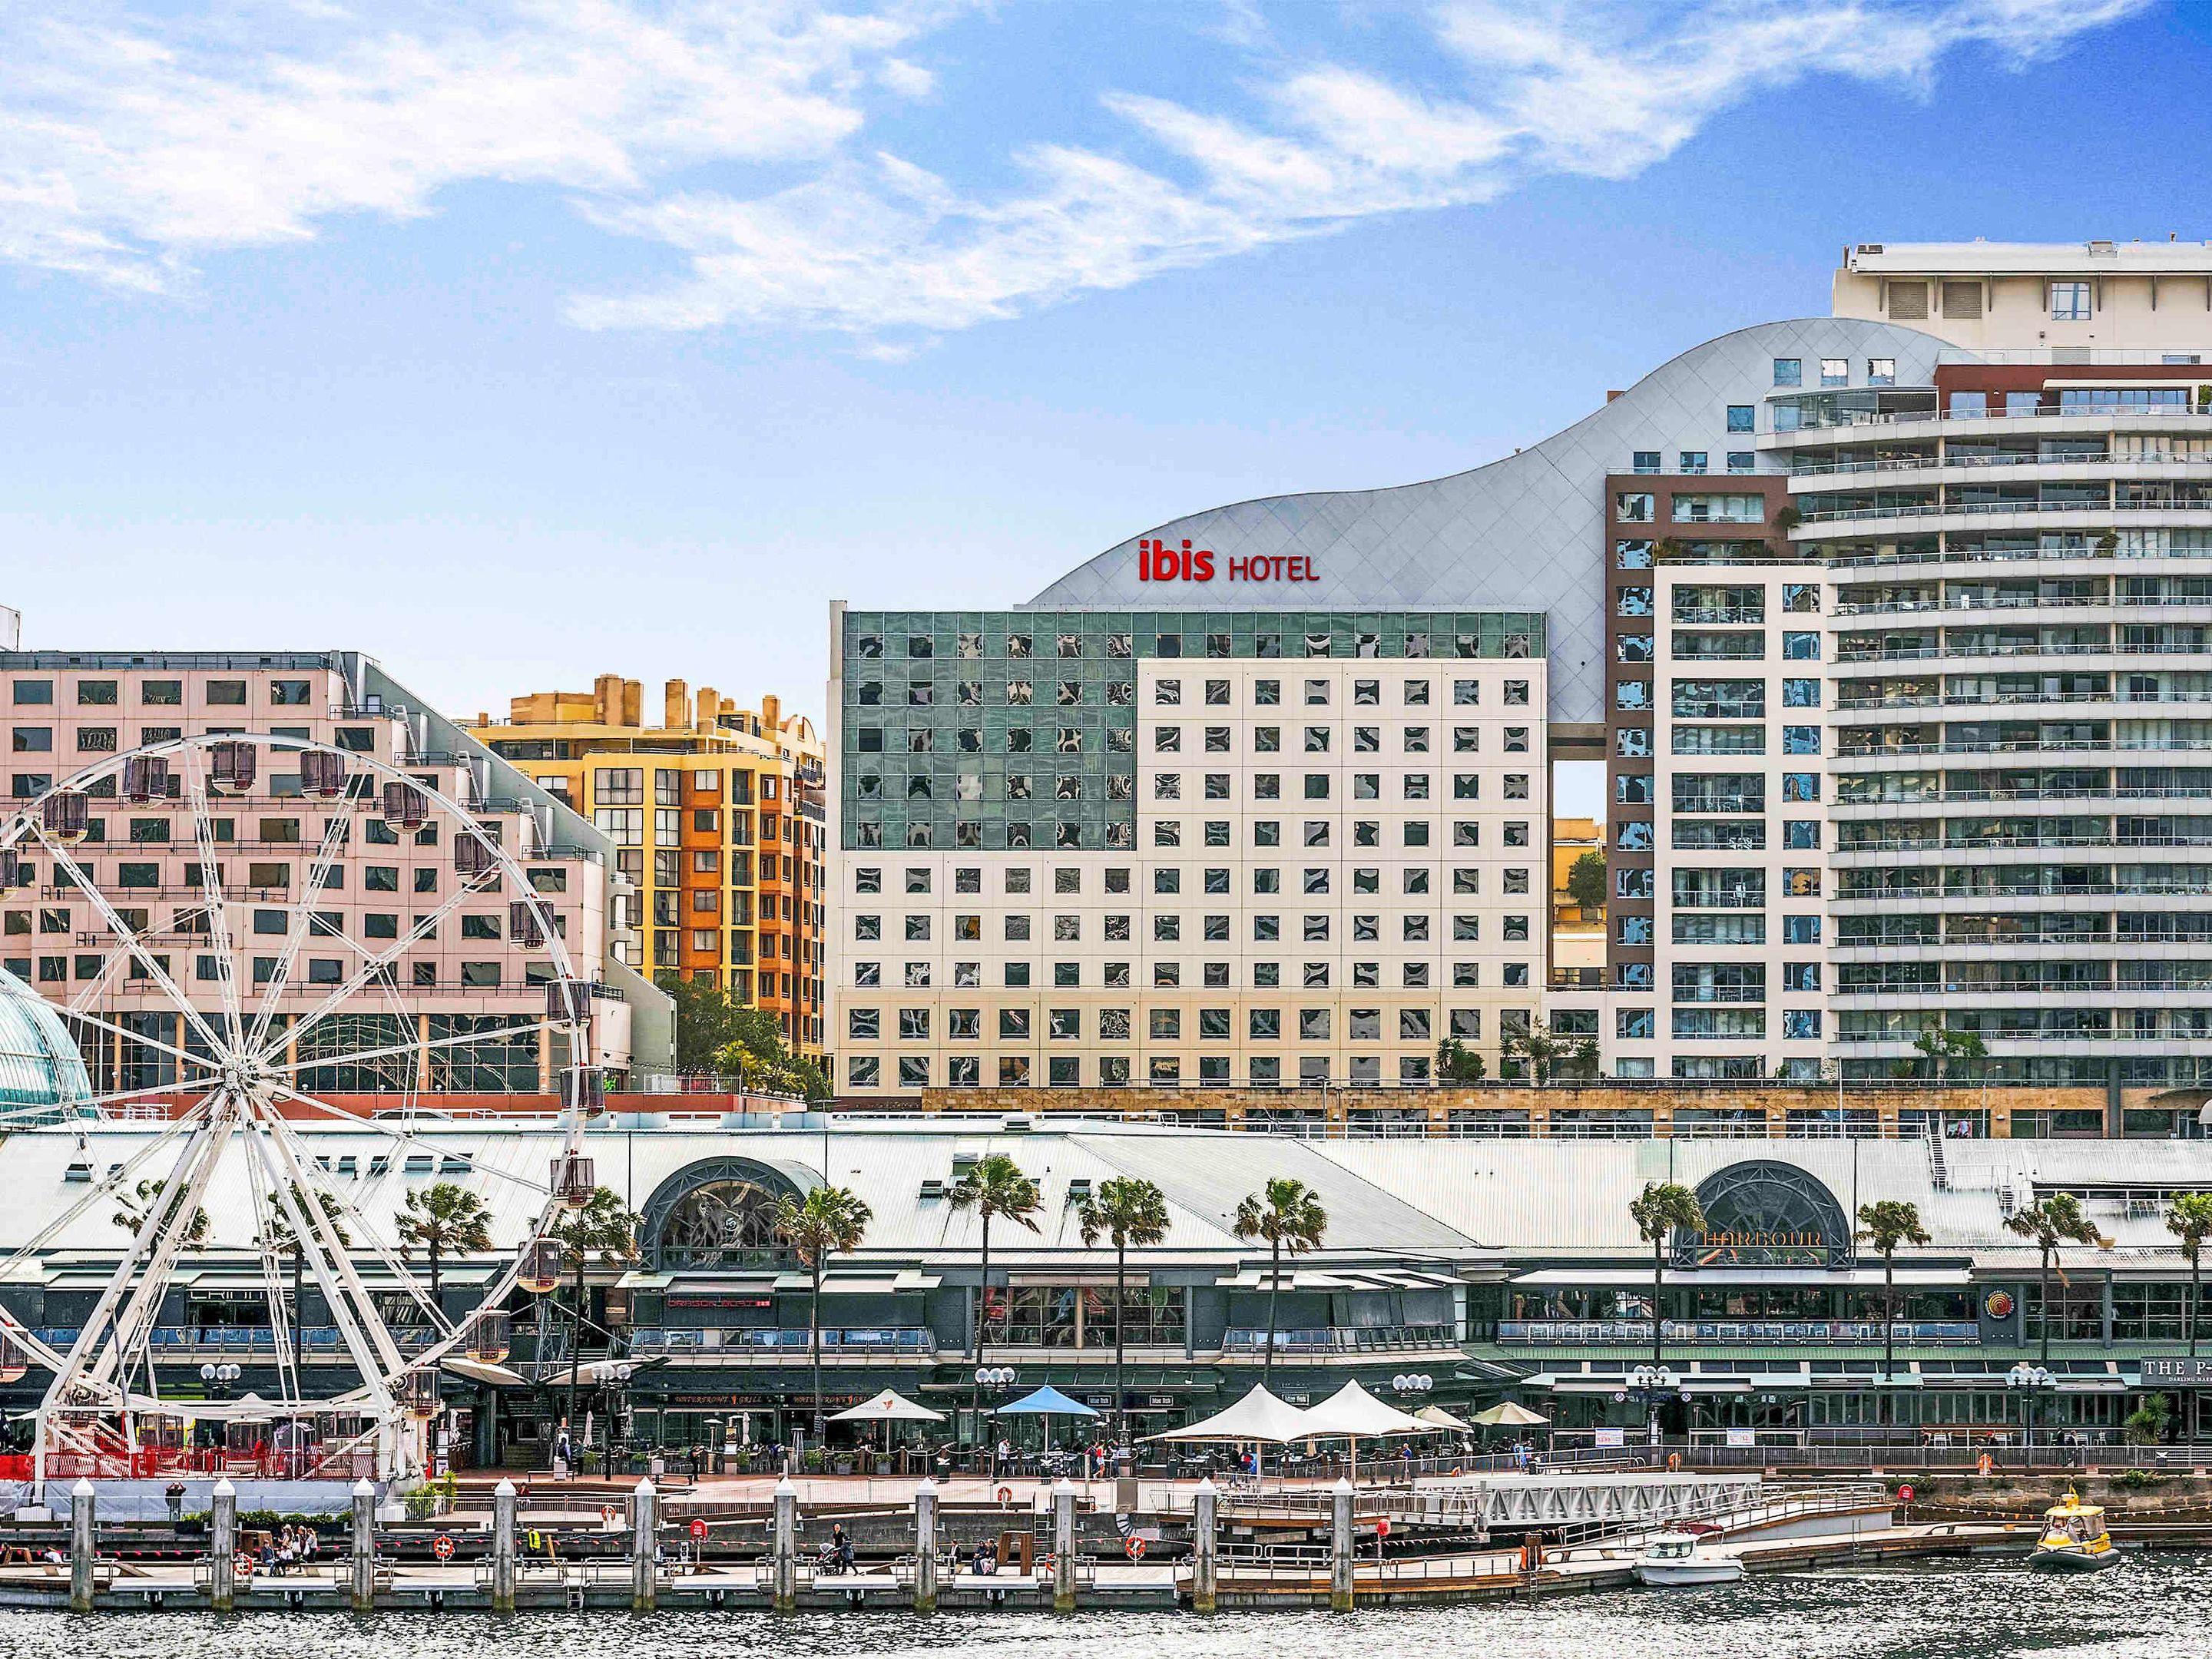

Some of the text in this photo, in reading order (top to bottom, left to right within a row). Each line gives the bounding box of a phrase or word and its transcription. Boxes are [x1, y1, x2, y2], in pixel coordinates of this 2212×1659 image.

[1138, 539, 1320, 581] ibis HOTEL
[1703, 1231, 1821, 1247] HARBOUR
[2144, 1361, 2184, 1375] THE
